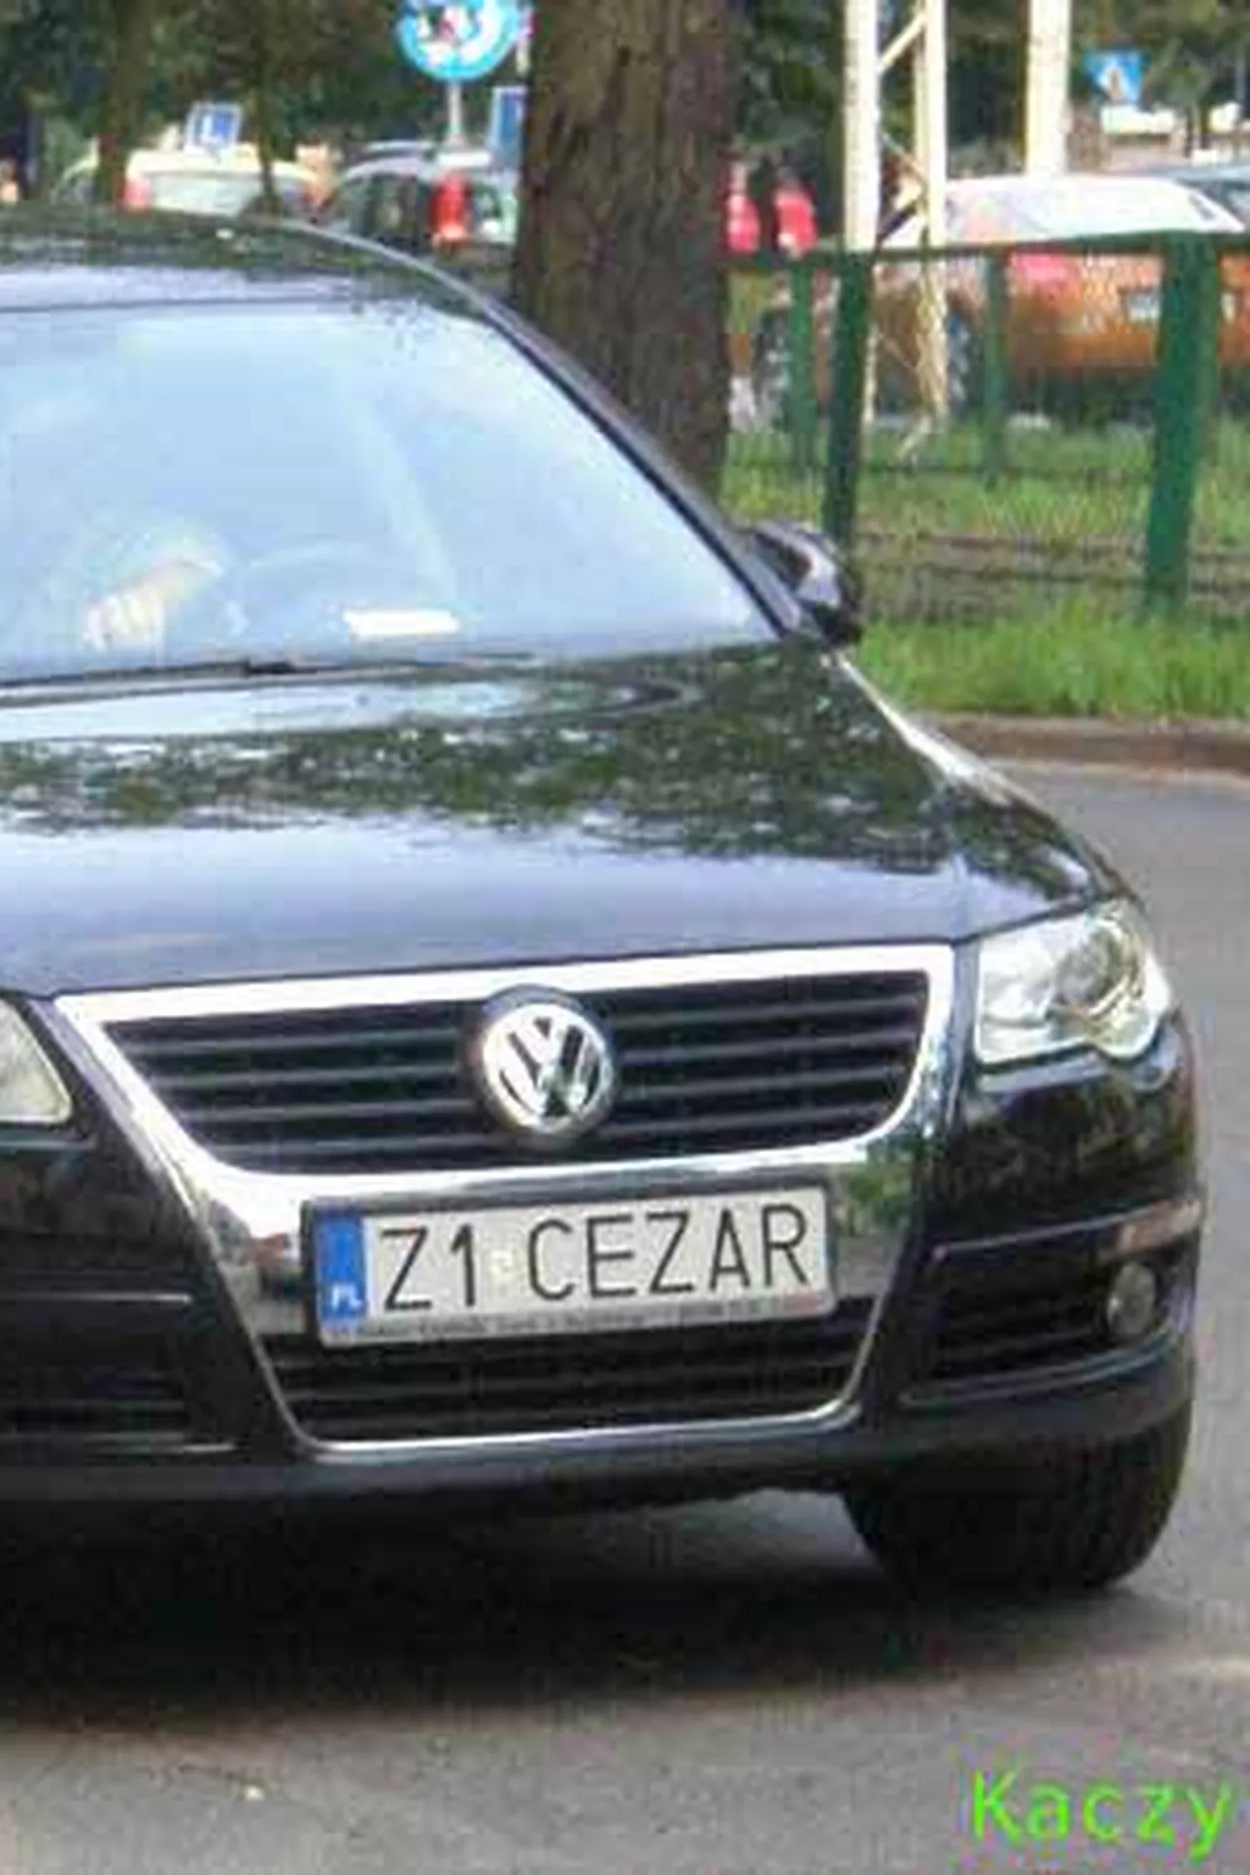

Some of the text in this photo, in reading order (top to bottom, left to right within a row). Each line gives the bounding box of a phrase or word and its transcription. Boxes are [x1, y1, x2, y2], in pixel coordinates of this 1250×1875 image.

[485, 1004, 609, 1126] VW
[380, 1202, 812, 1312] Z1 CEZAR
